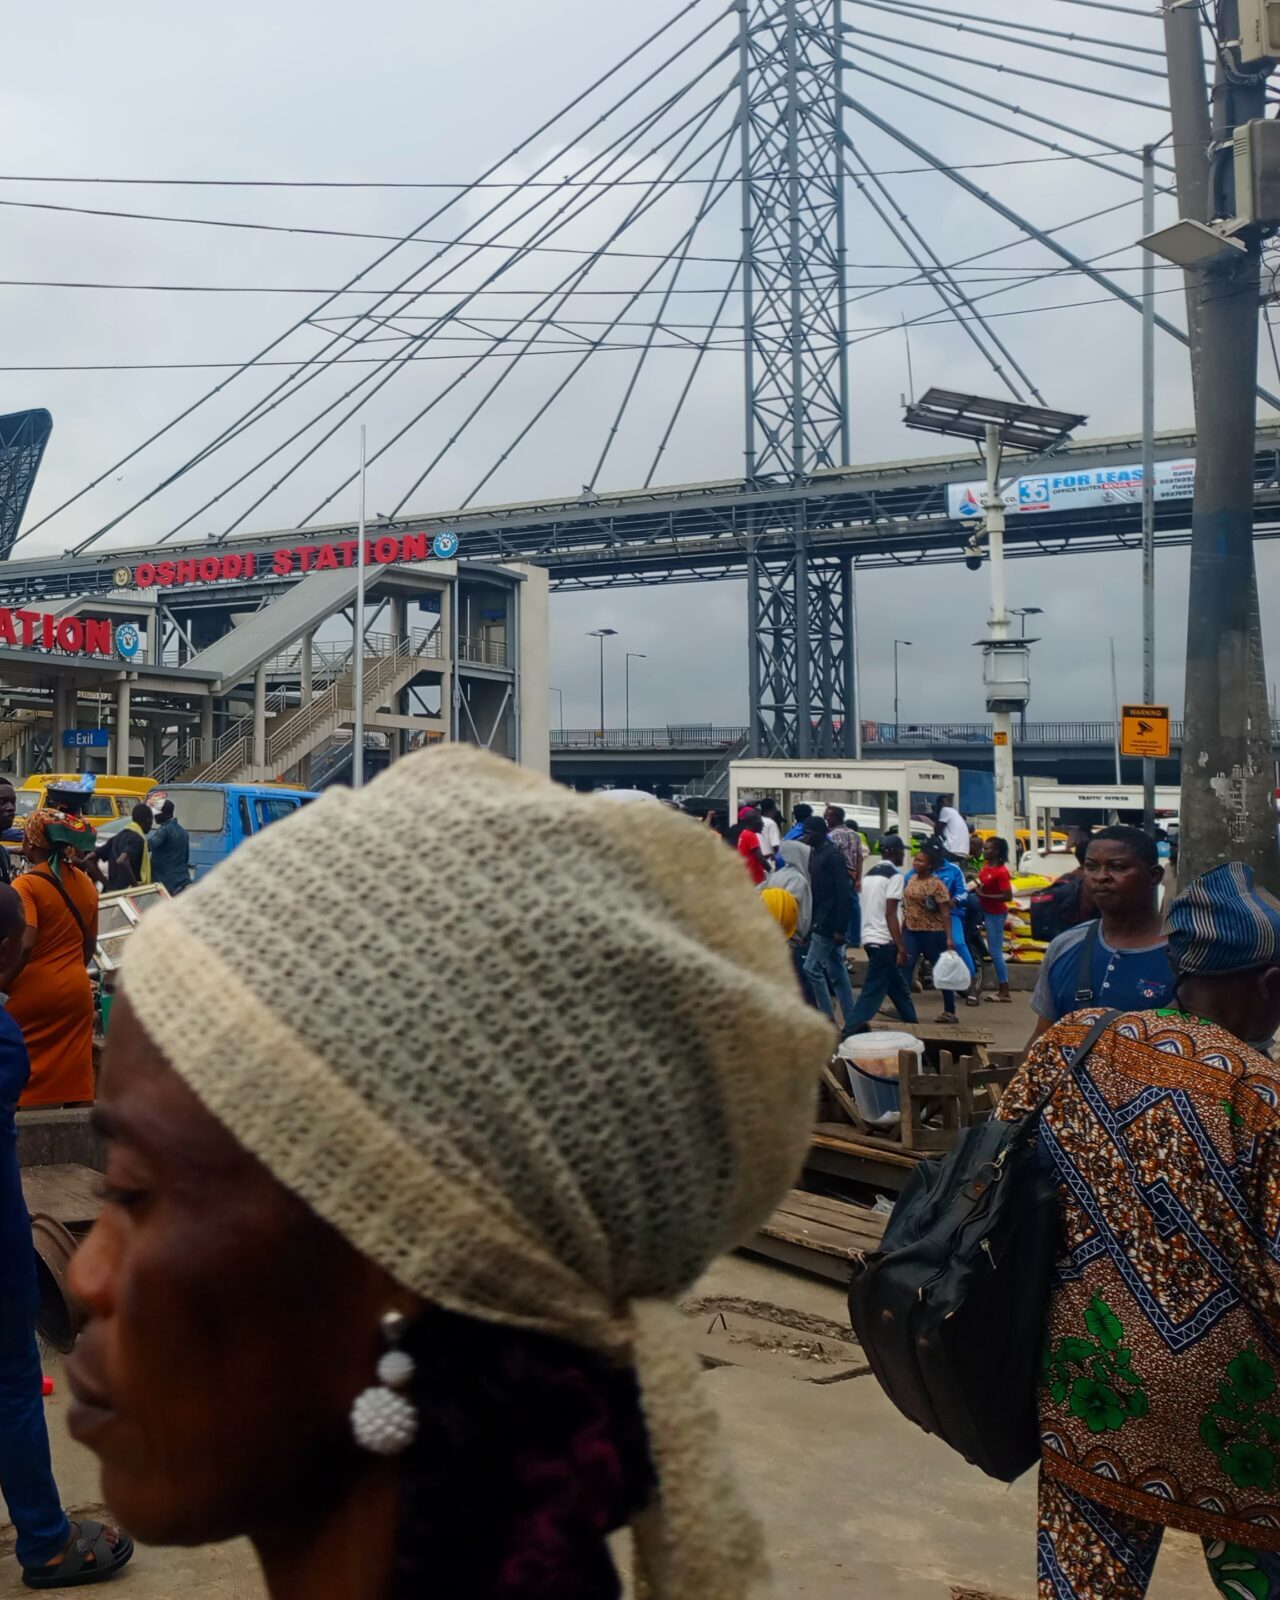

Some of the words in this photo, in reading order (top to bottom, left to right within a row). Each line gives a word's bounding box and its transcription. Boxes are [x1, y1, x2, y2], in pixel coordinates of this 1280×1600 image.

[1052, 474, 1090, 488] FOR
[1096, 468, 1155, 483] LEAS
[1021, 480, 1048, 503] 35
[135, 552, 255, 588] OSHODI
[272, 532, 427, 576] STATION
[76, 733, 94, 745] Exit
